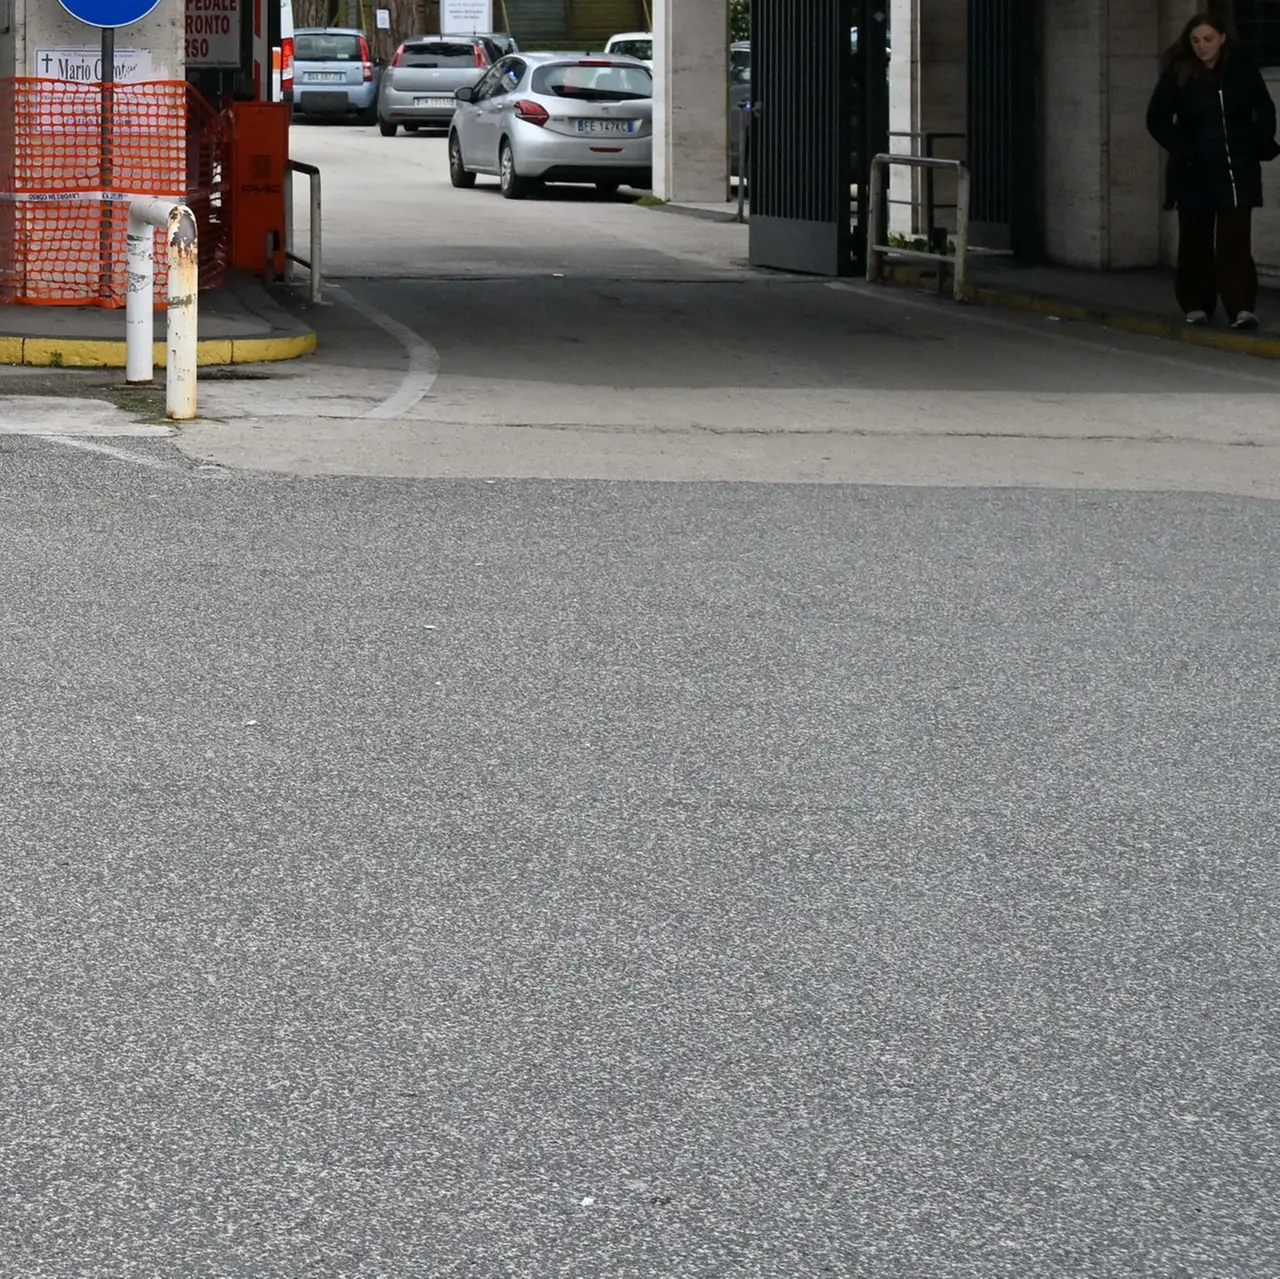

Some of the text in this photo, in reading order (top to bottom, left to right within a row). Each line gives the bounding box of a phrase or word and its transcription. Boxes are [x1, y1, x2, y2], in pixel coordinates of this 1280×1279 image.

[185, 15, 230, 35] RONTO
[184, 38, 209, 58] RSO
[58, 58, 91, 81] Mario
